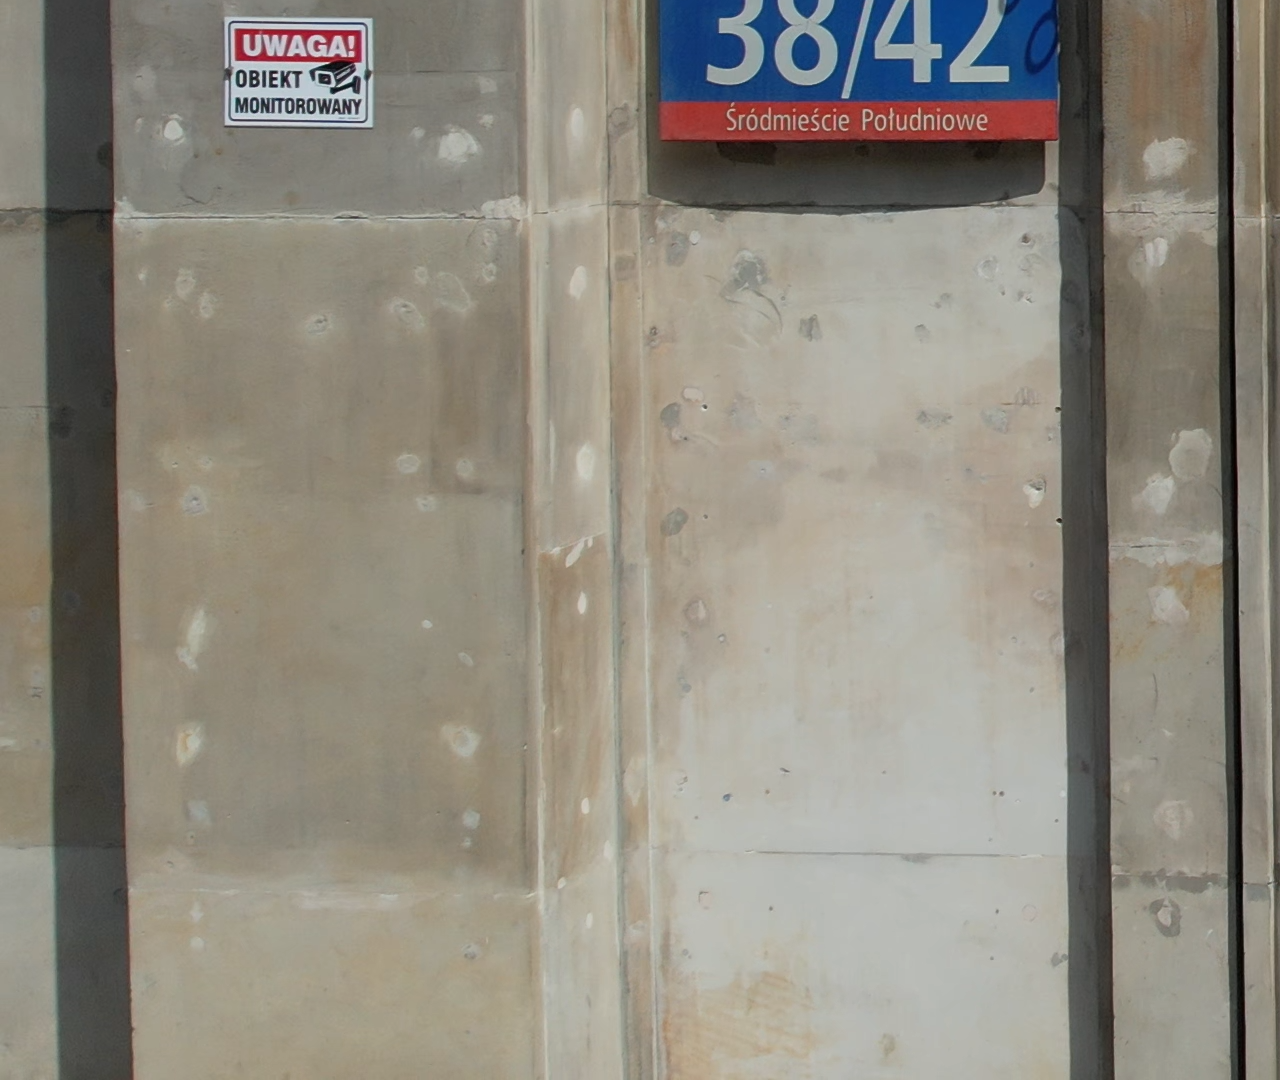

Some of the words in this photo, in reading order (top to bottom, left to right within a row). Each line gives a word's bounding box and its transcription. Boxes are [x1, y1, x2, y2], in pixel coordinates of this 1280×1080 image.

[242, 34, 356, 58] UWAGA!
[235, 69, 303, 89] OBIEKT
[234, 97, 362, 116] MONITOROWANY
[726, 102, 850, 132] Śródmieście
[861, 107, 989, 132] Południowe
